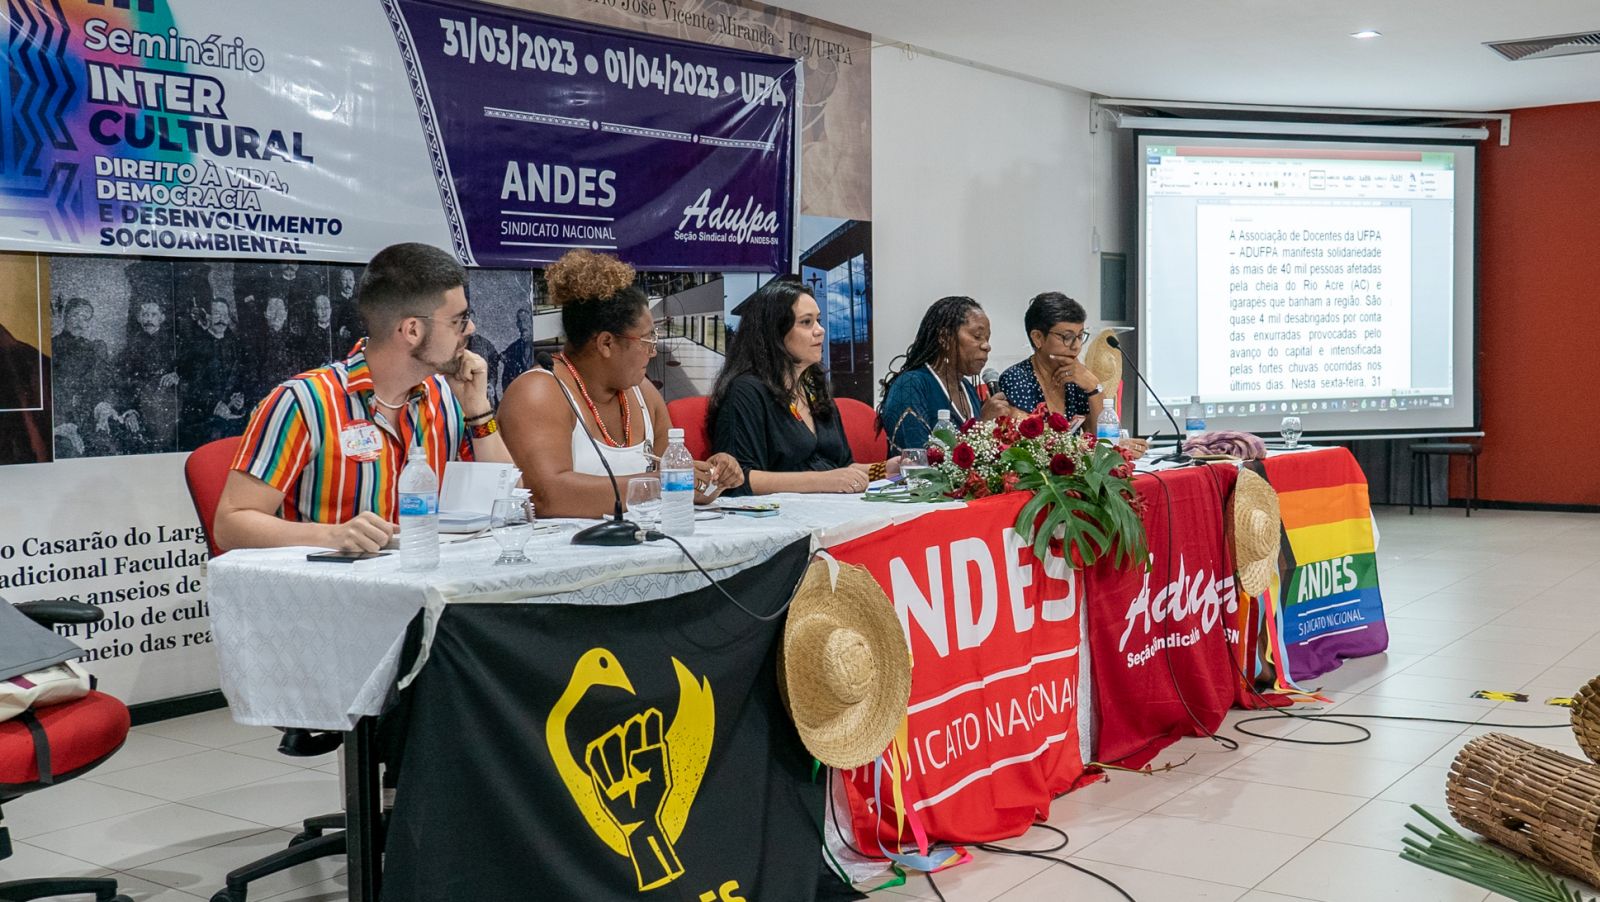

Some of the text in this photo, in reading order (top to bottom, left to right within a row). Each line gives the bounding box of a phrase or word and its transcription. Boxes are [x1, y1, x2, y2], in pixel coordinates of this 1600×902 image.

[84, 18, 265, 73] Seminário
[662, 0, 715, 32] Vicente
[719, 14, 775, 46] Miranda
[788, 31, 853, 65] ICJ/UFPA
[440, 18, 786, 108] 31/03/2023 01/04/2023 UFPA
[86, 59, 228, 120] INTER
[89, 110, 313, 164] CULTURAL
[95, 156, 289, 194] DIREITO À VIDA,
[501, 160, 616, 208] ANDES
[96, 180, 261, 212] DEMOCRACIA
[101, 205, 342, 236] E DESENVOLVIMENTO
[501, 220, 616, 241] SINDICATO NACIONAL
[678, 188, 779, 245] Adufpa
[100, 227, 306, 254] SOCIOAMBIENTAL
[674, 230, 697, 242] Seção
[699, 232, 727, 242] Sindical
[728, 233, 737, 242] do
[1229, 229, 1382, 243] A Associação de Docentes da UFPA
[1239, 246, 1278, 258] ADUFPA
[1282, 246, 1323, 258] manifesta
[1327, 246, 1382, 258] solidariedade
[1243, 264, 1264, 275] mais
[1267, 263, 1277, 274] de
[1280, 263, 1291, 274] 40
[1294, 263, 1307, 274] mil
[1310, 264, 1344, 277] pessoas
[1347, 263, 1382, 274] afetadas
[1229, 279, 1382, 293] pela cheia do Rio Acre (AC) e
[1269, 298, 1285, 310] que
[1288, 296, 1322, 307] banham
[1326, 297, 1331, 307] a
[1365, 294, 1382, 306] São
[1229, 312, 1382, 326] quase 4 mil desabrigados por conta
[1229, 328, 1382, 342] das enxurradas provocadas pelo
[1230, 344, 1382, 360] avanço do capital e intensificada
[1229, 360, 1382, 377] pelas fortes chuvas ocorridas nos
[1230, 379, 1261, 392] últimos
[1291, 377, 1316, 389] Nesta
[1371, 375, 1381, 387] 31
[22, 531, 118, 558] Casarão
[124, 527, 151, 547] do
[0, 558, 107, 589] adicional
[1297, 555, 1358, 603] ANDES
[87, 575, 201, 607] anseios de
[889, 523, 1076, 667] NDES
[85, 610, 135, 641] polo
[141, 606, 167, 626] de
[1298, 609, 1365, 637] SIDICATO NCIONAL
[77, 639, 134, 664] meio
[139, 633, 177, 653] das
